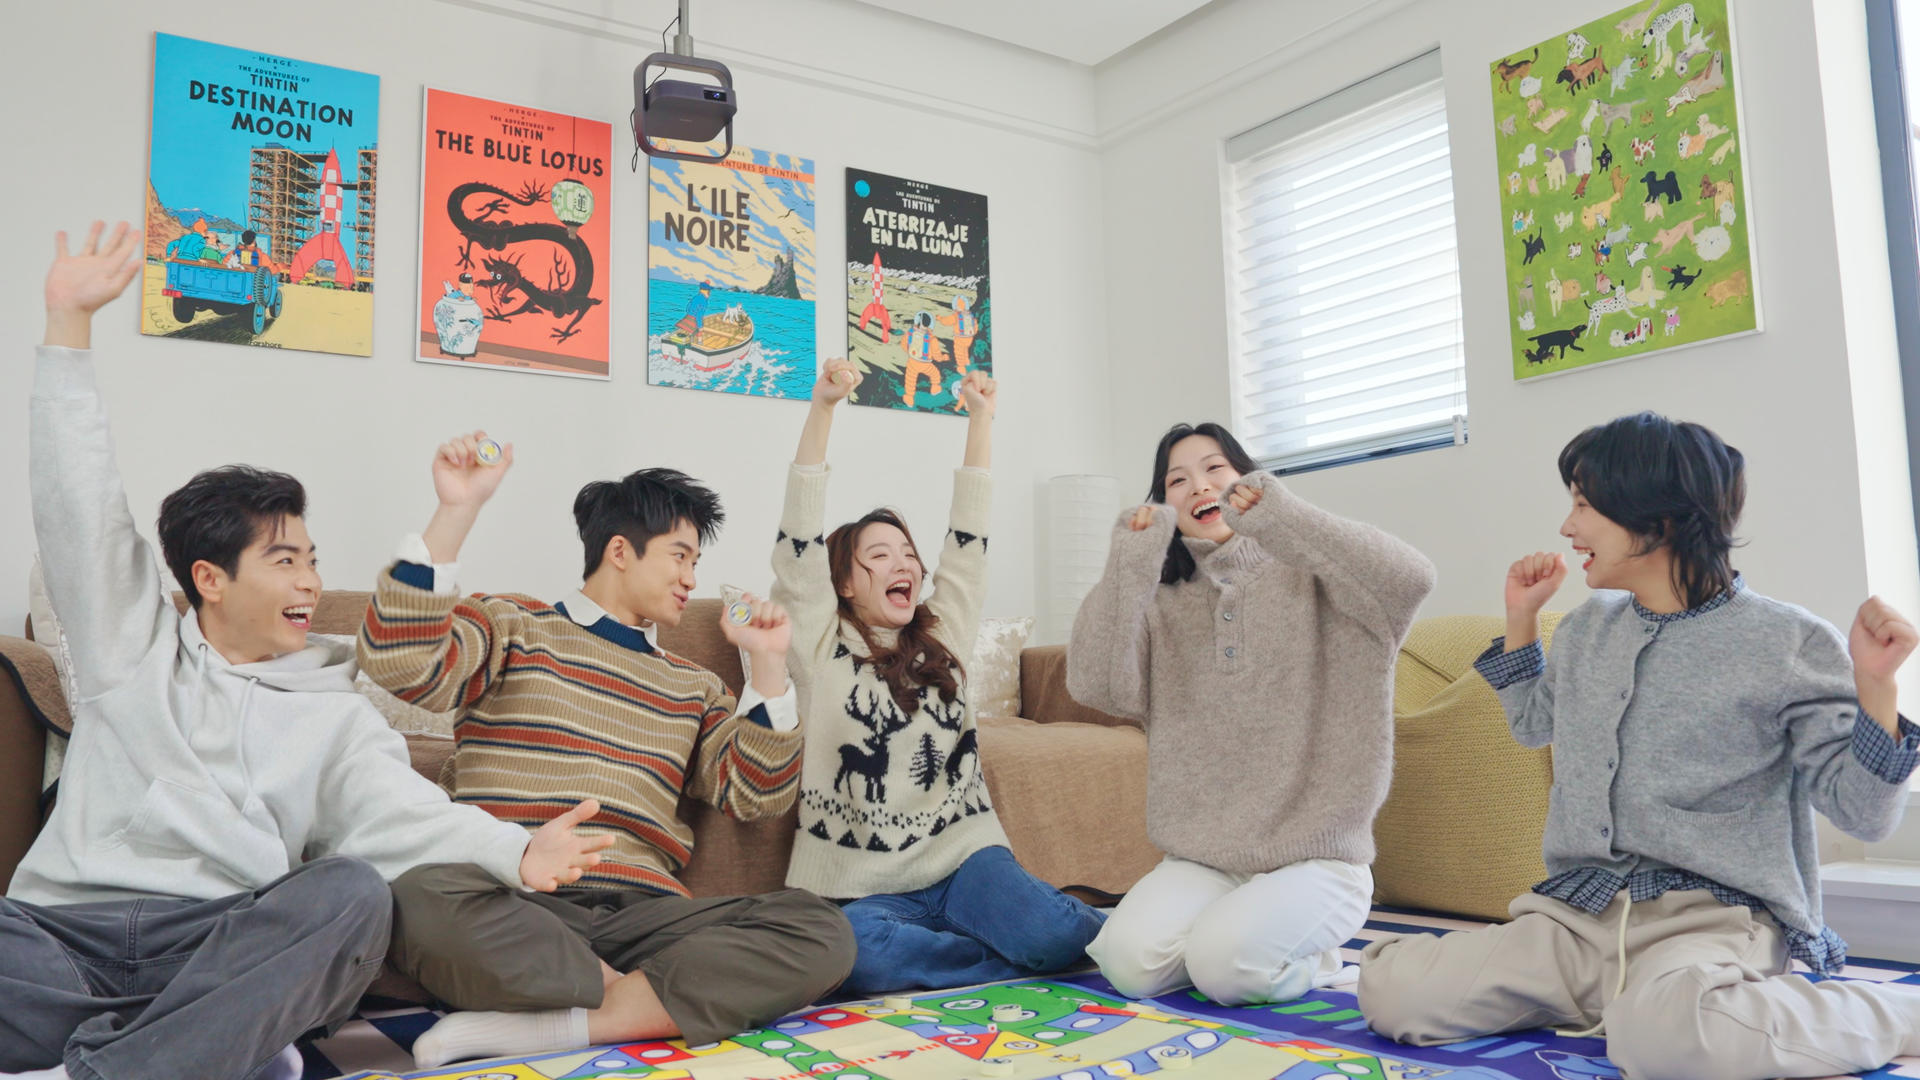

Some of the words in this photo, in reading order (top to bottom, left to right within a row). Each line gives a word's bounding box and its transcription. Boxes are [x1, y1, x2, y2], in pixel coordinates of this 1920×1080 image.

[250, 74, 298, 93] TINTIN
[254, 68, 298, 81] ADVENTURES
[189, 80, 353, 127] DESTINATION
[231, 111, 312, 143] MOON
[501, 123, 544, 142] TINTIN
[505, 118, 544, 130] ADVENTURES
[435, 129, 474, 155] THE
[483, 138, 532, 165] BLUE
[541, 149, 604, 177] LOTUS
[758, 166, 768, 175] DE
[771, 168, 800, 181] TINTIN
[902, 198, 935, 213] TINTIN
[664, 212, 750, 253] NOIRE
[862, 207, 969, 243] ATERRIZAJE
[871, 226, 893, 246] EN
[897, 232, 918, 250] LA
[921, 236, 964, 258] LUNA
